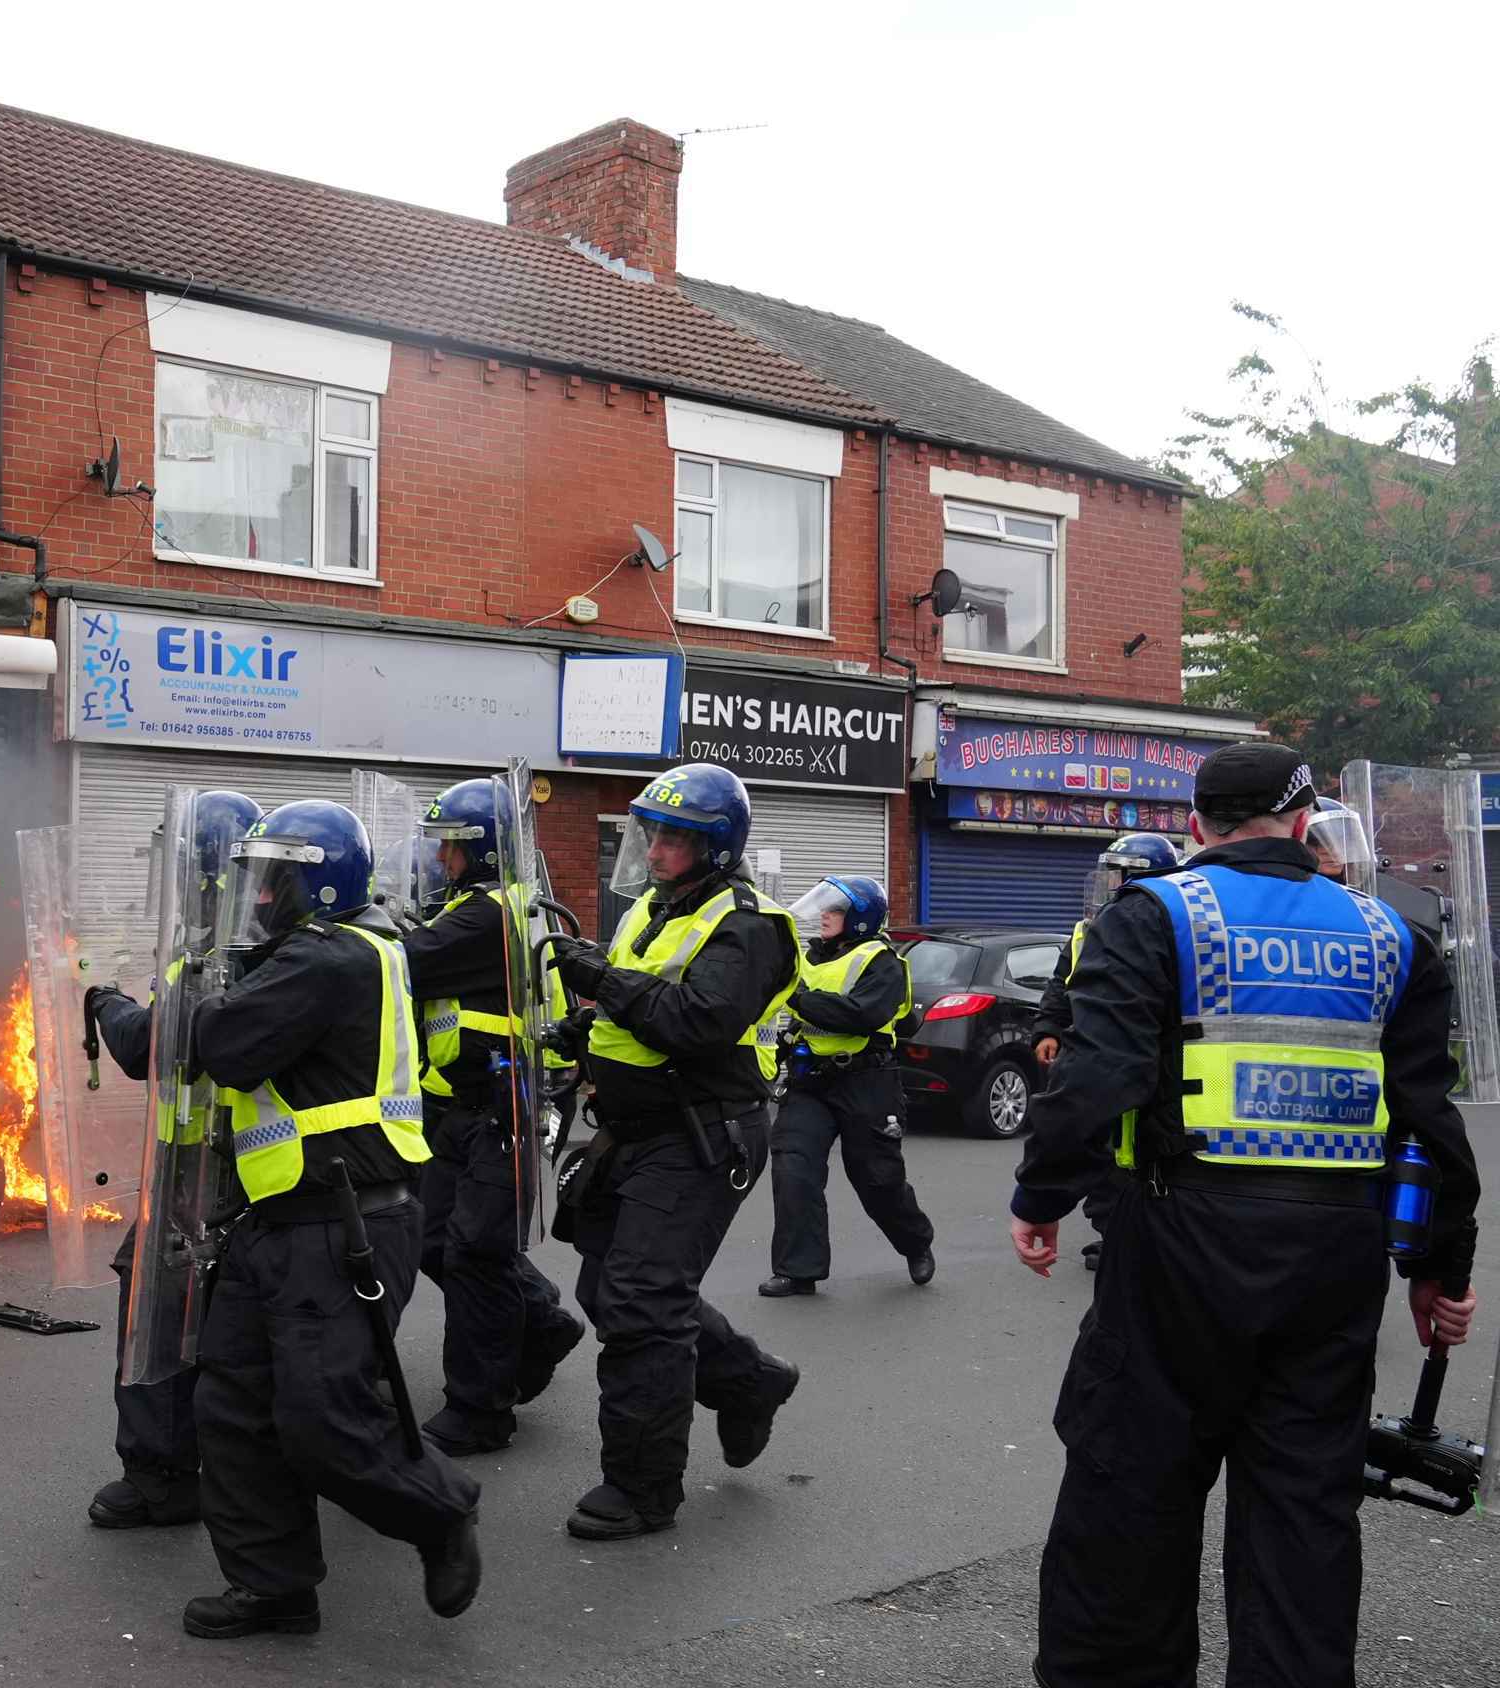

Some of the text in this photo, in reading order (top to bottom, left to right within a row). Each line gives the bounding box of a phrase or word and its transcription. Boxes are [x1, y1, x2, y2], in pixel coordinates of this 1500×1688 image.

[156, 626, 298, 681] Elixir
[159, 678, 238, 692] ACCOUNTANCY
[251, 685, 299, 697] TAXATION
[171, 692, 201, 703] Email:
[185, 706, 266, 719] www.elixirbs.com
[680, 691, 762, 731] EN'S
[769, 700, 903, 743] HAIRCUT
[140, 721, 158, 732] Tel:
[162, 723, 194, 734] 01642
[243, 728, 273, 738] 07404
[690, 740, 740, 762] 07404
[744, 745, 804, 767] 302265
[961, 729, 1206, 777] BUCHAREST MINI MARK
[1233, 935, 1372, 981] POLICE
[1249, 1067, 1370, 1100] POLICE
[1243, 1100, 1371, 1121] FOOTBALL UNIT
